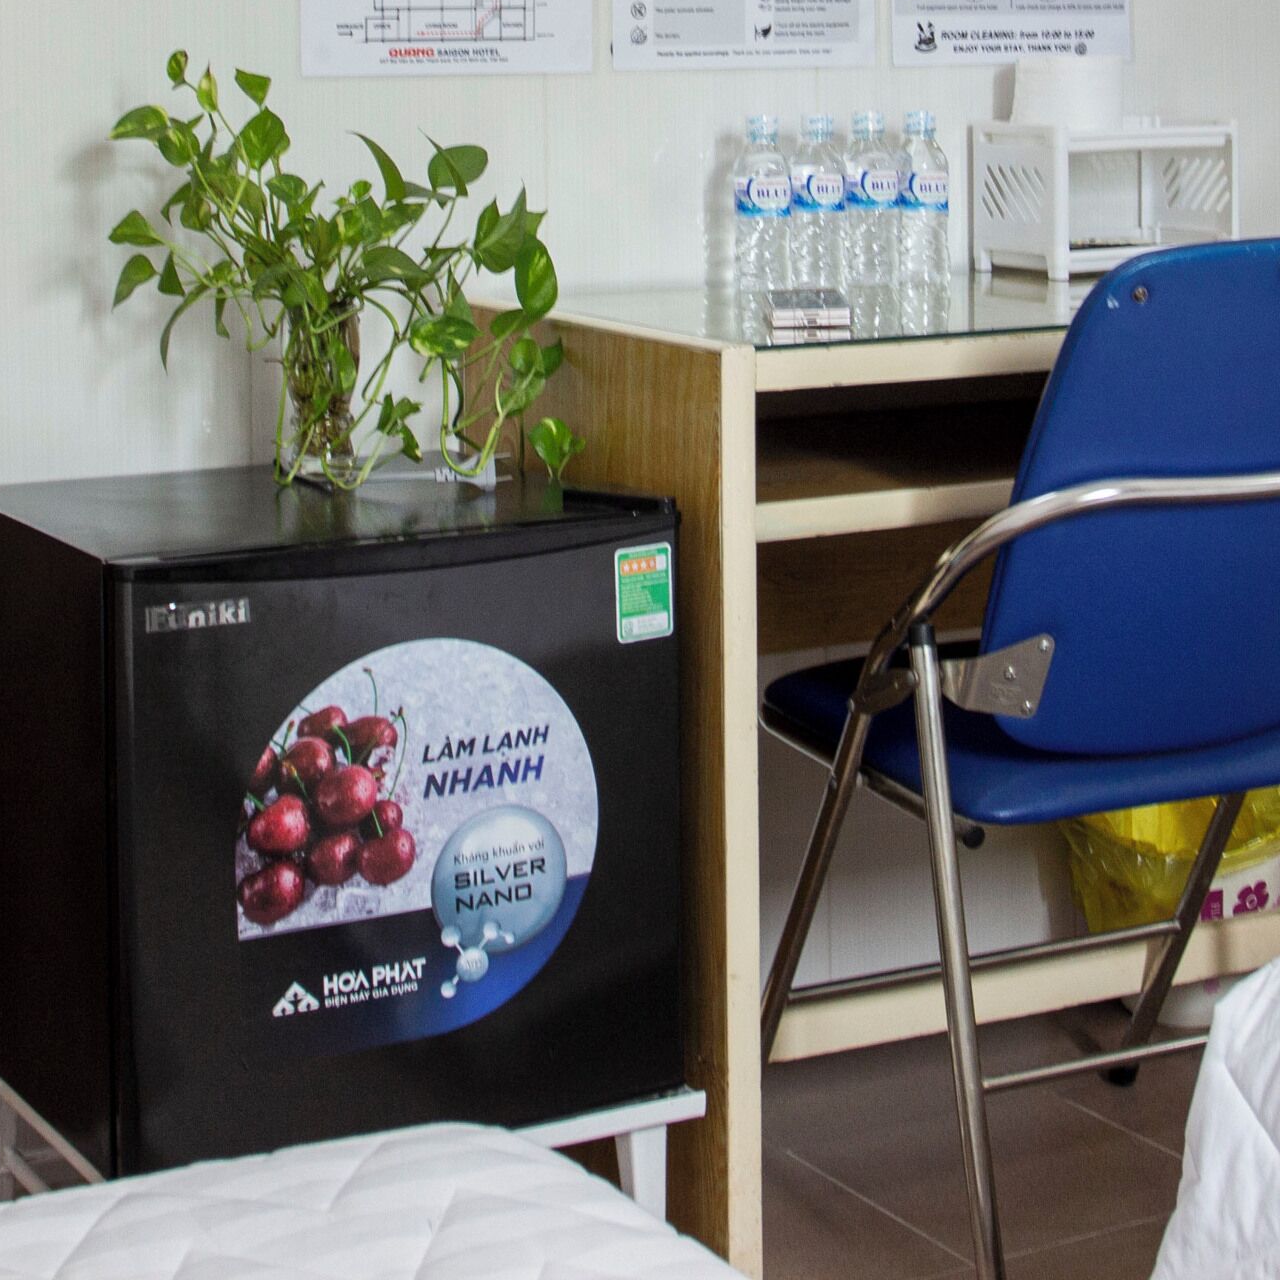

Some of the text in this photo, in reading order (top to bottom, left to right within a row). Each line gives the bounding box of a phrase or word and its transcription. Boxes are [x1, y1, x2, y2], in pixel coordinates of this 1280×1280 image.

[941, 29, 968, 40] ROOM
[437, 48, 470, 57] SAIGON
[472, 47, 501, 57] HOTEL
[953, 44, 978, 53] ENJOY
[981, 44, 1002, 53] YOUR
[1027, 44, 1052, 53] THANK
[422, 724, 550, 764] LÀM LẠNH
[423, 754, 545, 800] NHANH
[454, 856, 546, 890] SILVER
[455, 882, 532, 914] NANO
[372, 986, 389, 999] GIA
